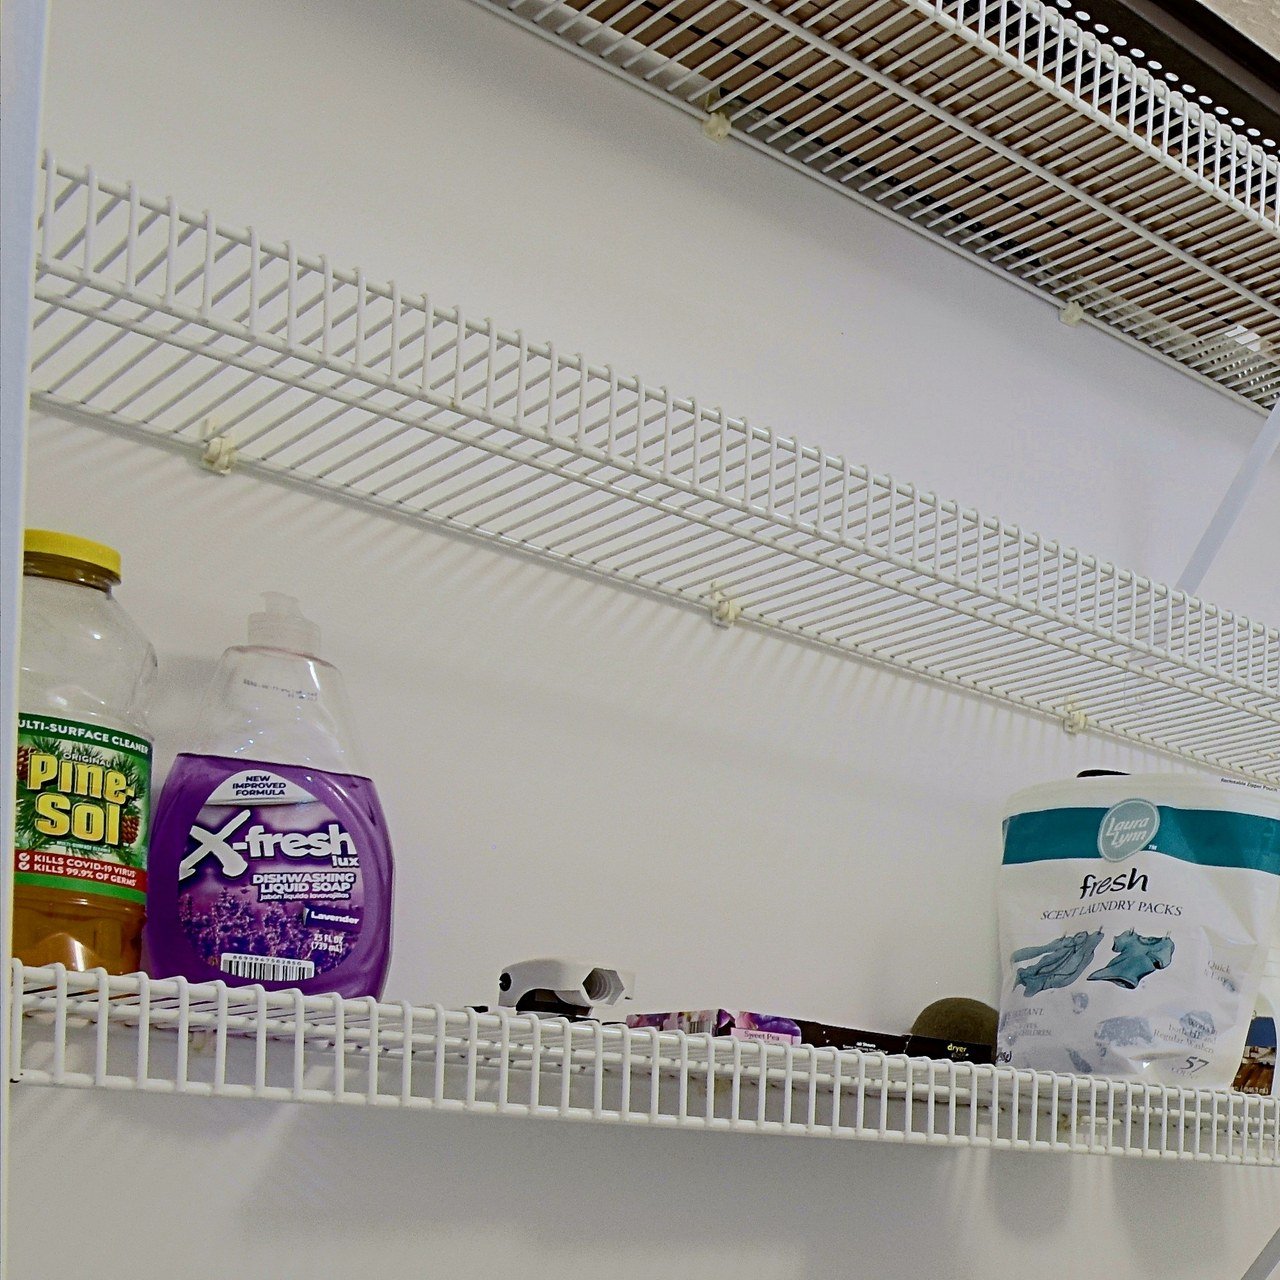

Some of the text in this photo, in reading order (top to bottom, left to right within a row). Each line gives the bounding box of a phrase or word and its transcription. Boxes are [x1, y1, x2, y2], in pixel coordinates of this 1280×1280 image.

[18, 718, 149, 753] ULTI-SURFACE CLEANER
[62, 752, 112, 768] ORIGINAL
[27, 752, 135, 805] Pine-
[246, 775, 271, 783] NEW
[235, 789, 286, 797] FORMULA
[34, 791, 121, 846] Sol
[1106, 817, 1150, 836] Laura
[178, 809, 358, 882] X-fresh
[1111, 830, 1147, 848] Lynn
[34, 855, 64, 866] KILLS
[66, 858, 113, 873] COVID-19
[332, 855, 360, 867] lux
[33, 863, 64, 875] KILLS
[66, 867, 94, 879] 99.9%
[95, 872, 110, 881] OF
[252, 873, 355, 884] DISHWASHING
[261, 882, 351, 894] LIQUID SOAP
[1079, 867, 1148, 899] fresh
[310, 911, 360, 925] Lavender
[1040, 900, 1183, 921] SCENT LAUNDRY PACKS
[744, 1031, 780, 1041] Sweet Pea
[947, 1043, 967, 1053] dryer
[1180, 1056, 1210, 1073] 57
